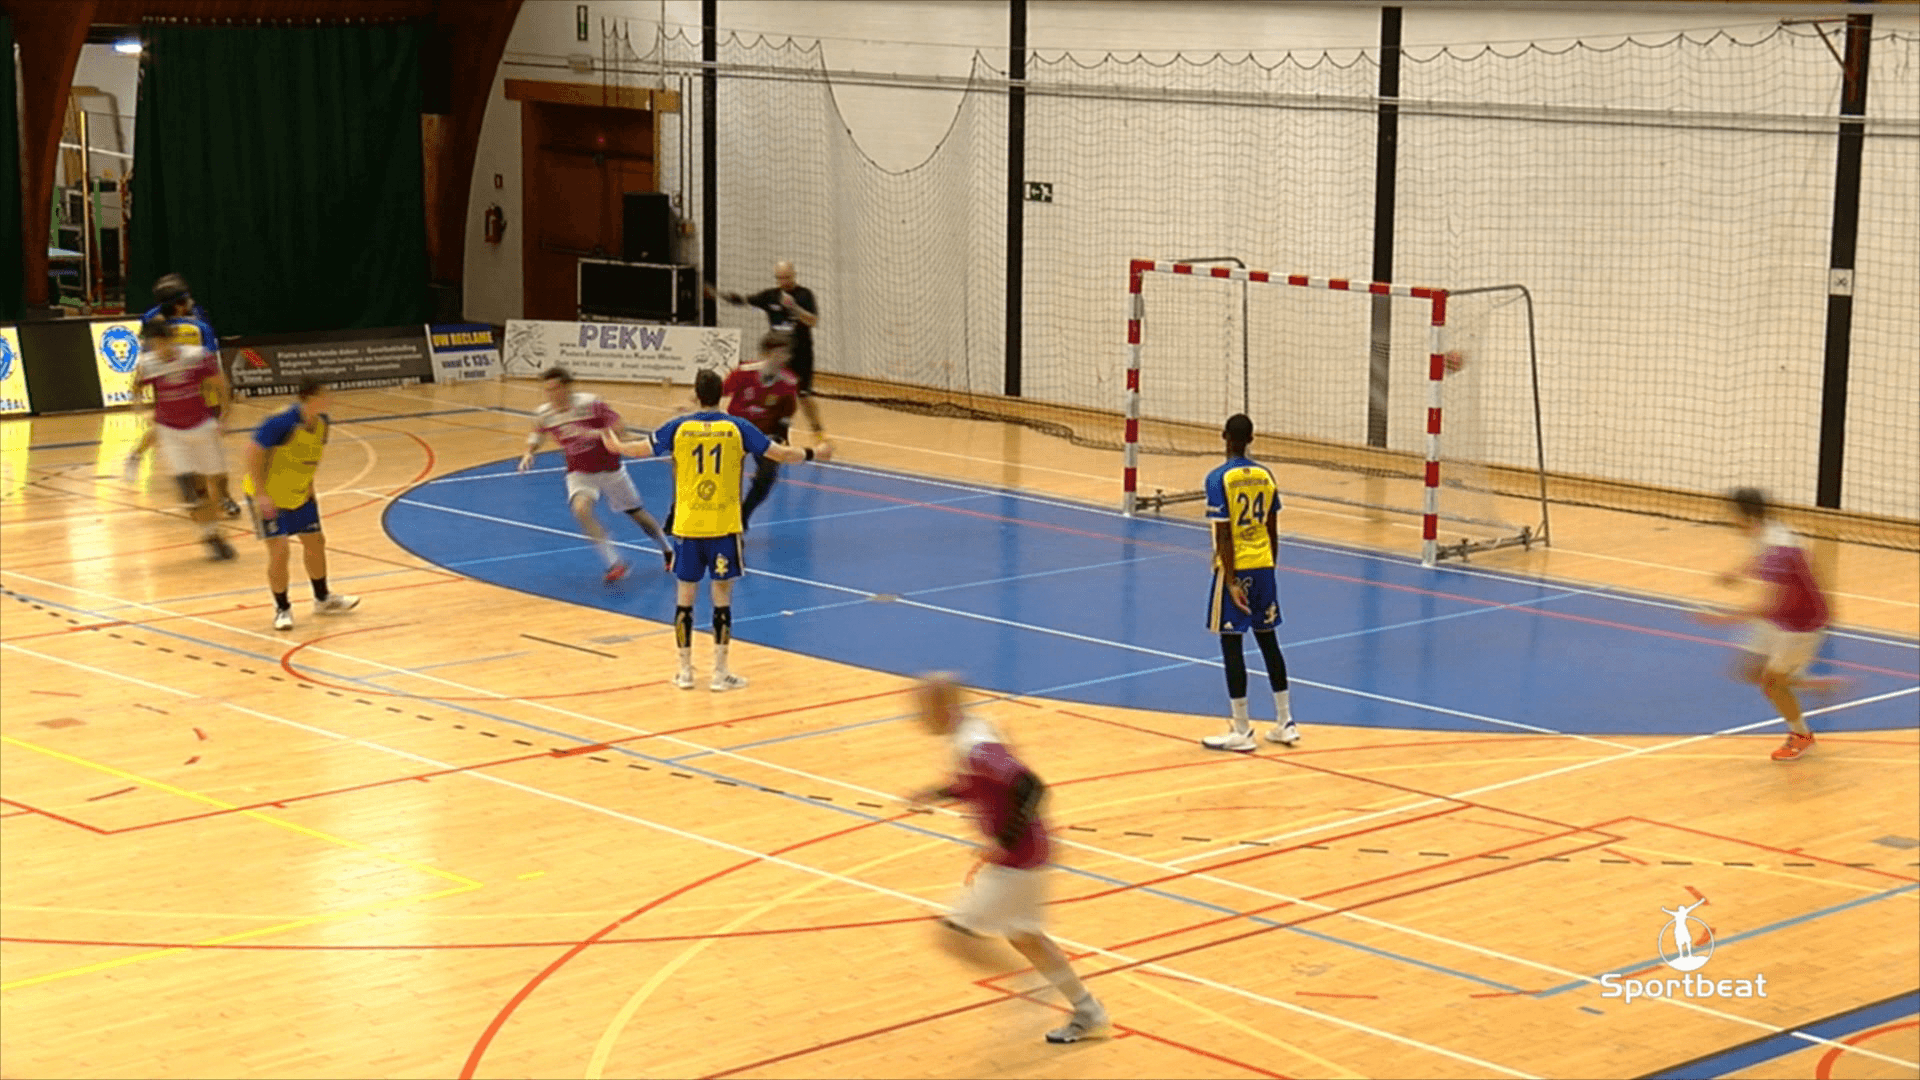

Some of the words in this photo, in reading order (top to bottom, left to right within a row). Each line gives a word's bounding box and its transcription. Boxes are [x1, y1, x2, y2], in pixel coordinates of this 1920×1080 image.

[450, 330, 494, 345] RECLAME
[579, 324, 667, 351] PEKW
[692, 443, 722, 474] 11
[1237, 491, 1265, 526] 24
